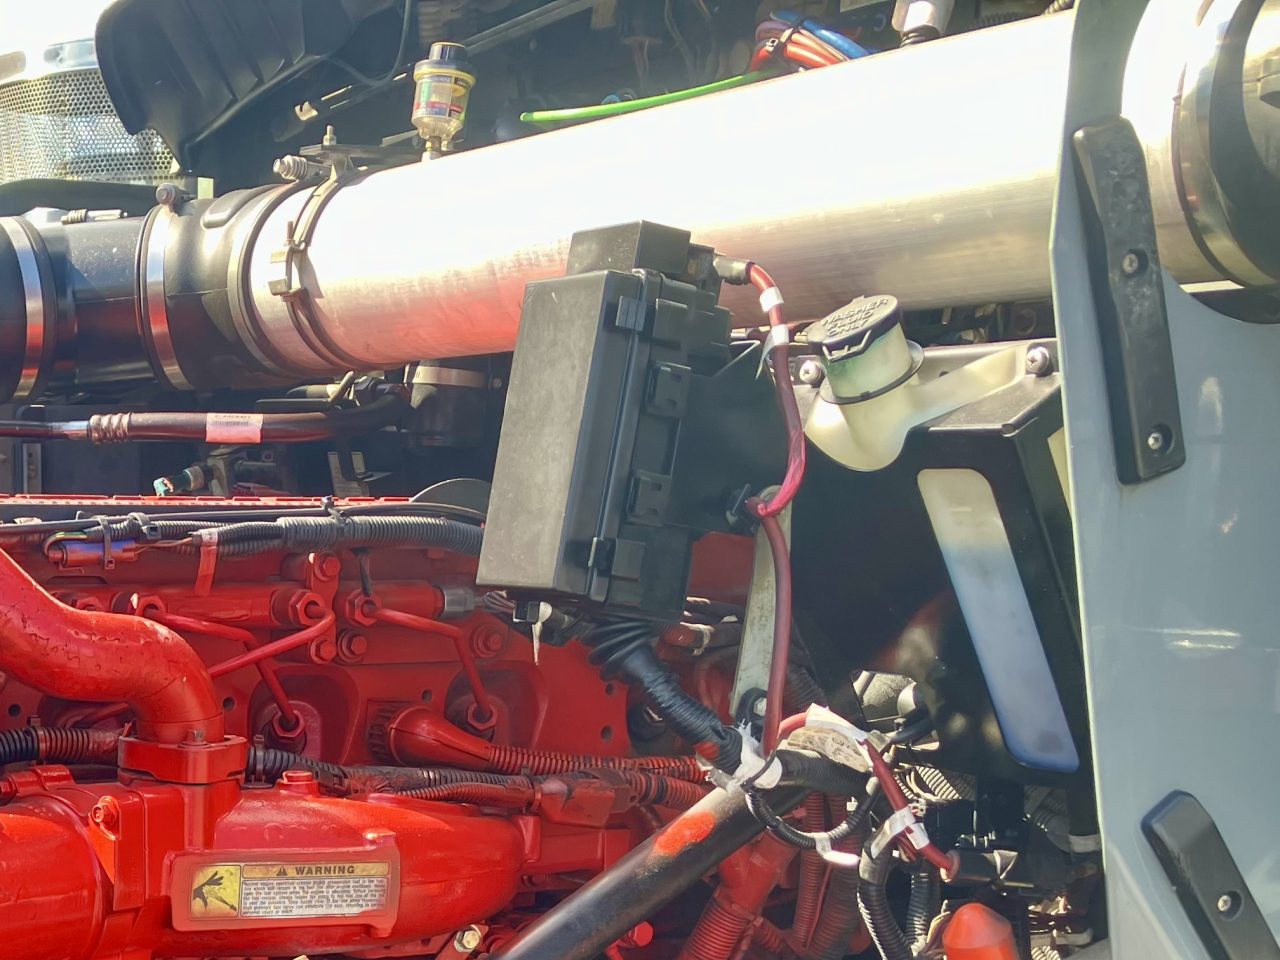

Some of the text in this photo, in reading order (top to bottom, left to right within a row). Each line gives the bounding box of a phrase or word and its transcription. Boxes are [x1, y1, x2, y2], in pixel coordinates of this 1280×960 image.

[822, 298, 889, 326] WASHER
[828, 310, 874, 331] FLUID
[828, 320, 869, 337] ONLY
[295, 865, 355, 876] WARNING
